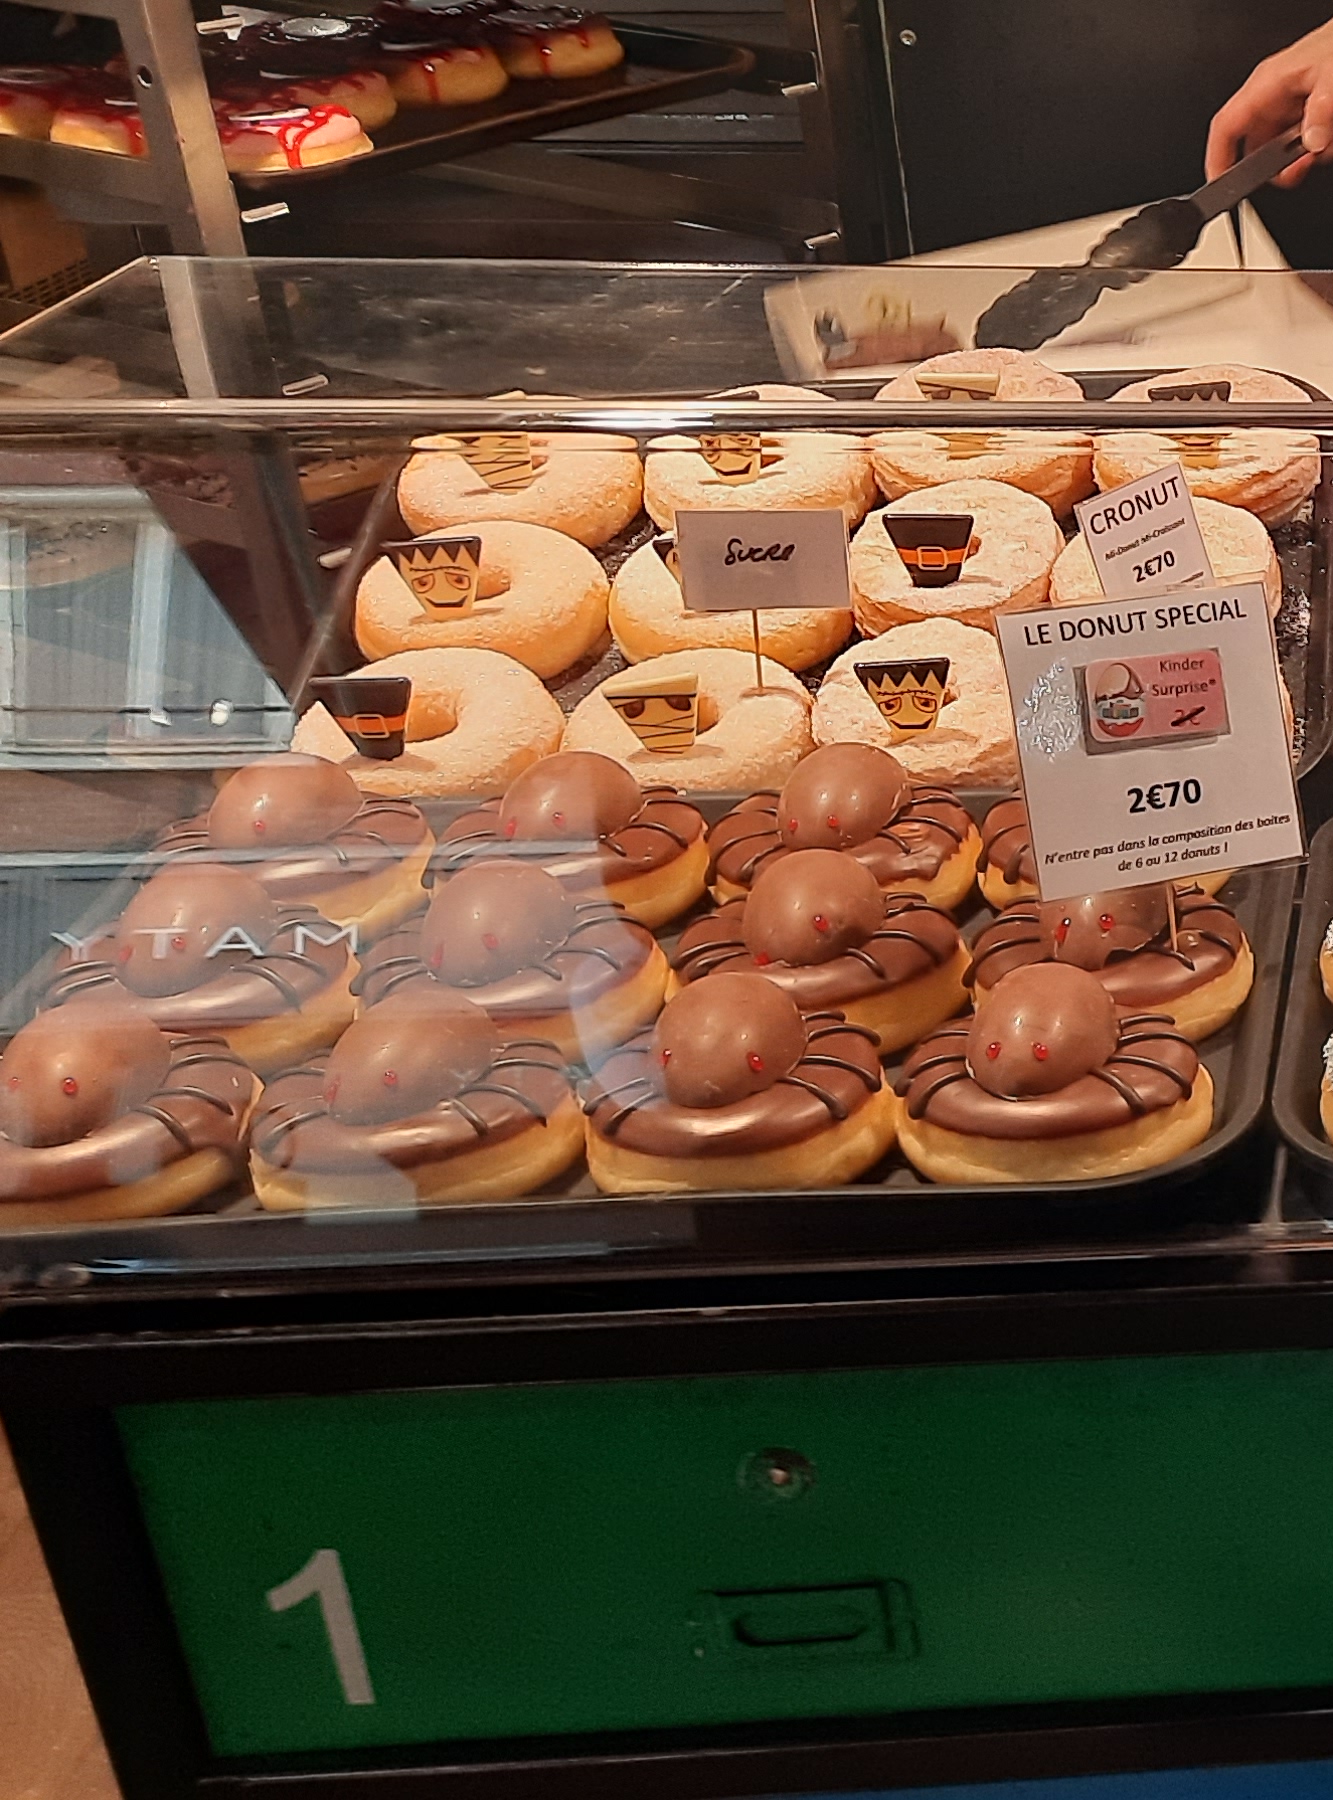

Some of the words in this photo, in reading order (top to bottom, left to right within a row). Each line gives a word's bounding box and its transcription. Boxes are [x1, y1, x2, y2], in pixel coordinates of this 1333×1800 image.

[1090, 476, 1178, 534] CRONUT
[724, 538, 795, 566] Sucre
[1133, 550, 1175, 582] 2€70
[1024, 623, 1052, 646] LE
[1059, 611, 1147, 642] DONUT
[1155, 599, 1247, 629] SPECIAL
[1159, 658, 1204, 672] Kinder
[1127, 778, 1201, 813] 2€70
[1093, 845, 1114, 858] pas
[1117, 840, 1145, 852] dans
[1148, 836, 1160, 847] la
[1162, 825, 1231, 842] composition
[1235, 821, 1253, 832] des
[1118, 860, 1132, 871] de
[1136, 858, 1143, 868] 6
[1164, 852, 1178, 863] 12
[1181, 845, 1220, 861] donuts
[266, 1548, 376, 1705] 1
